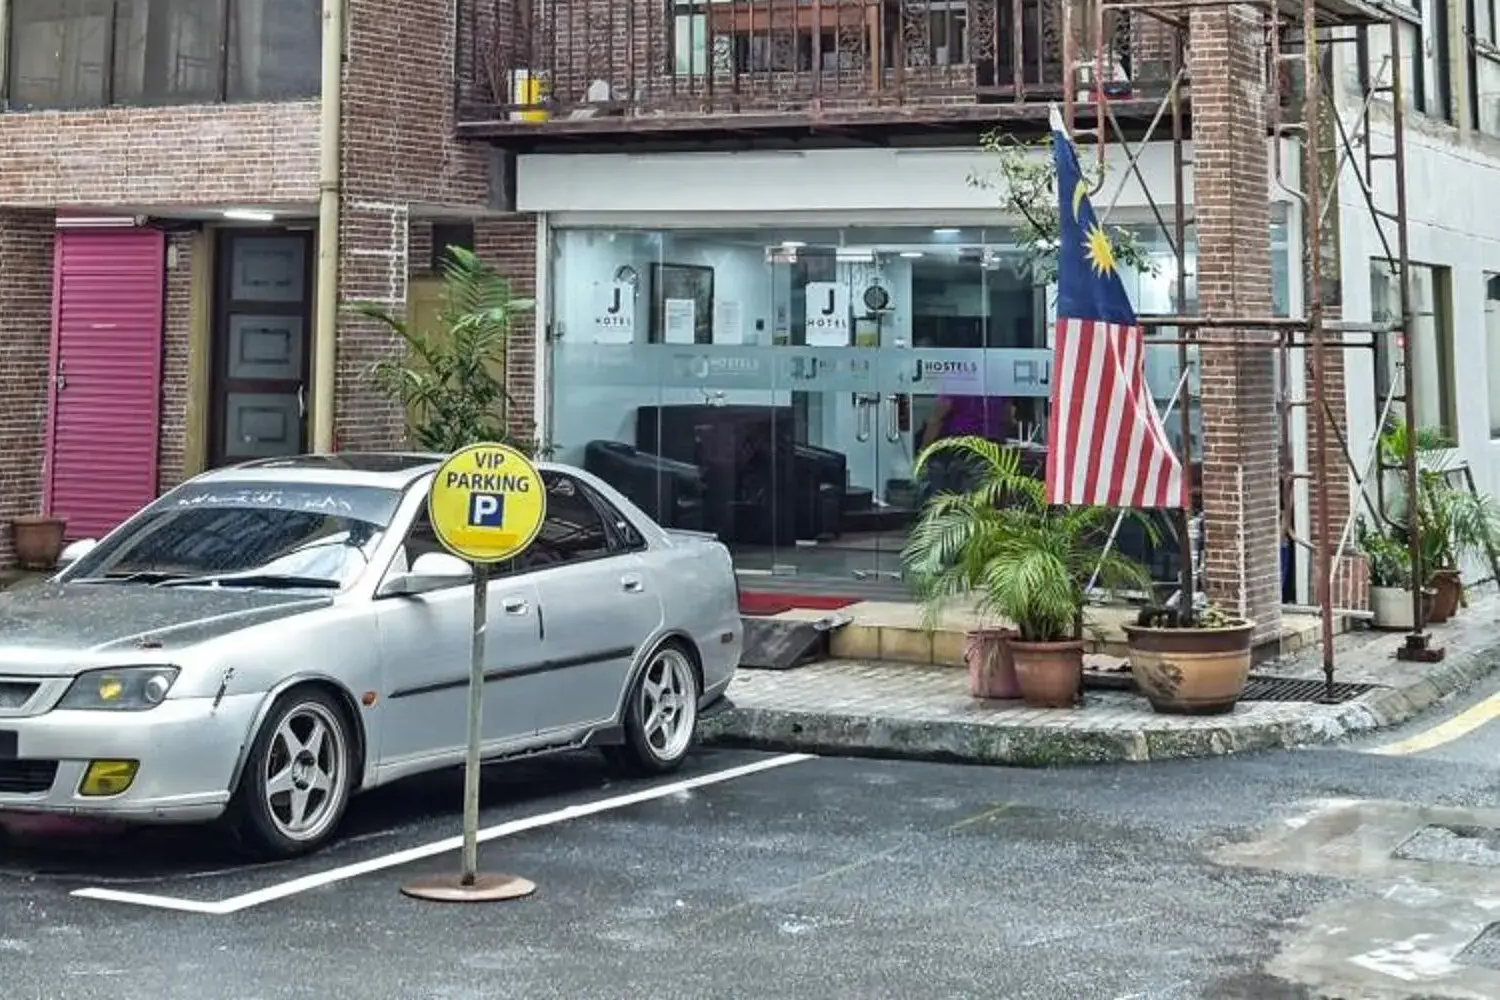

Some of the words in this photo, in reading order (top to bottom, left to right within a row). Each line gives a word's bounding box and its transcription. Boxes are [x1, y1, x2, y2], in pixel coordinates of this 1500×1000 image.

[607, 288, 620, 314] J
[822, 289, 834, 315] J
[806, 319, 847, 328] HOTEL
[912, 359, 922, 382] J
[925, 361, 977, 372] HOSTELS
[476, 452, 504, 468] VIP
[447, 472, 529, 492] PARKING
[474, 496, 498, 524] P
